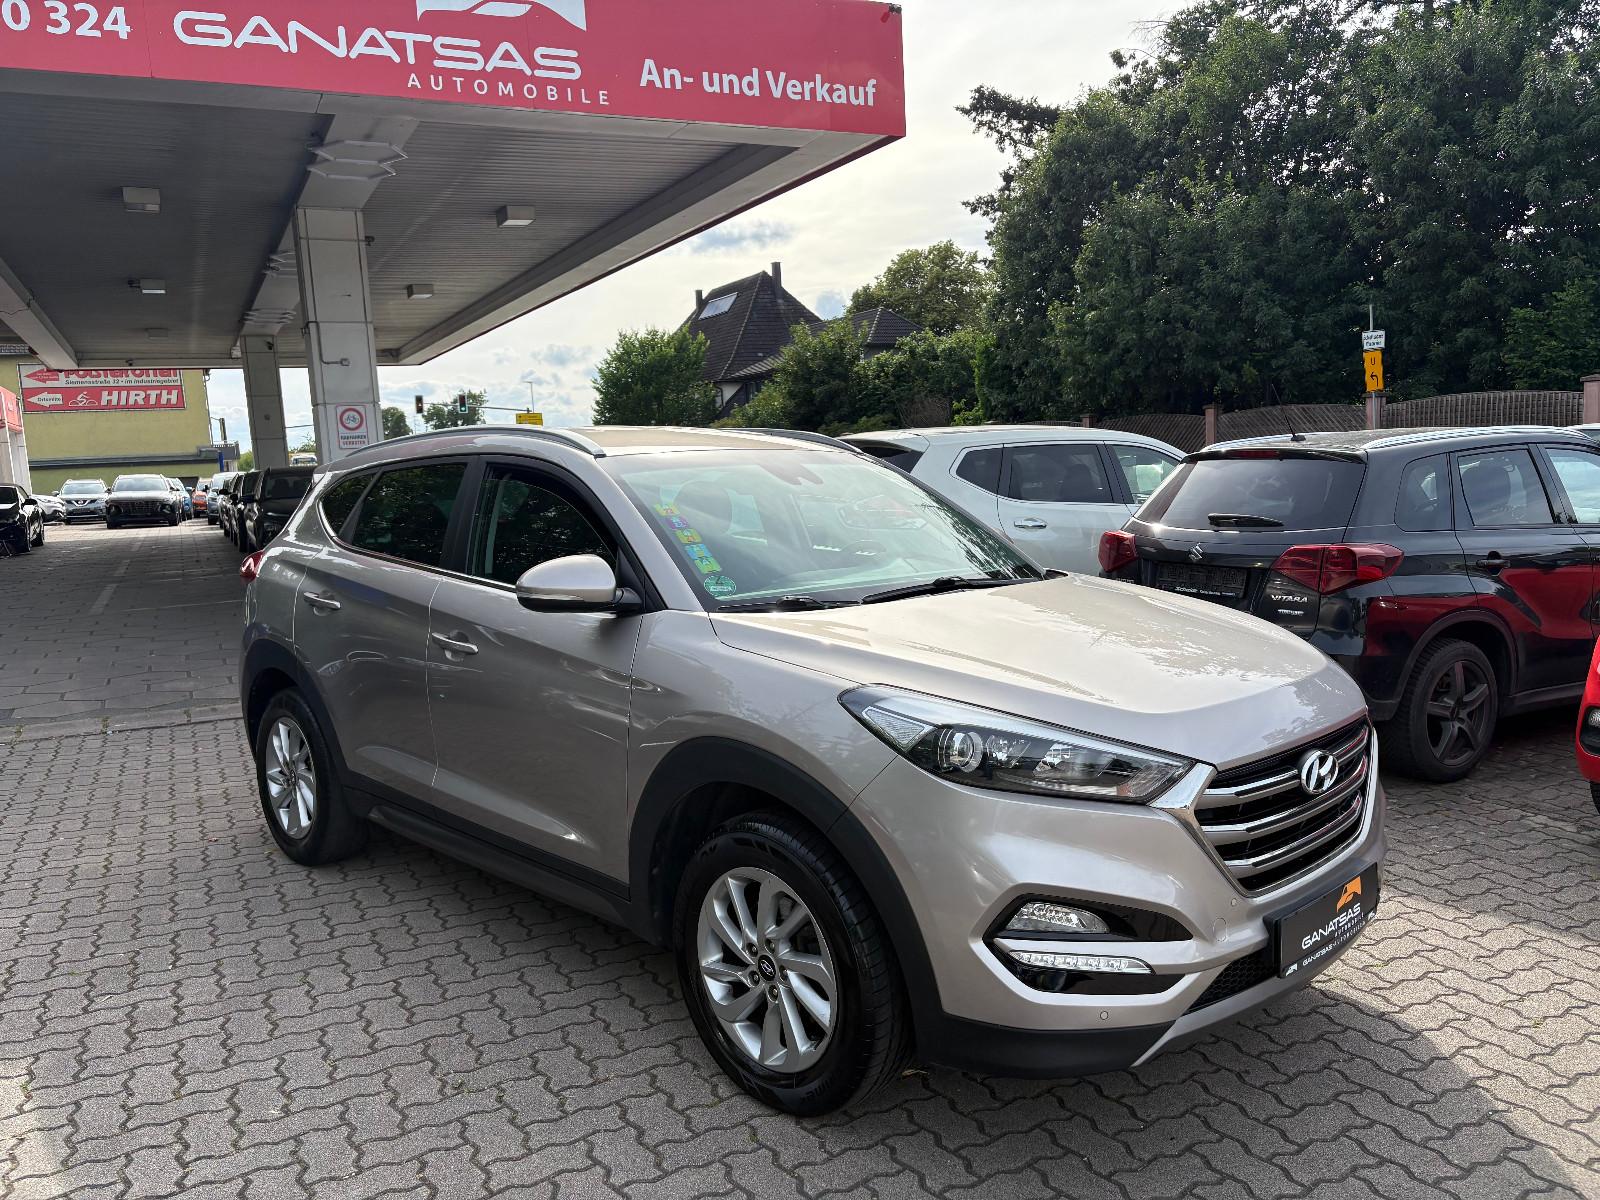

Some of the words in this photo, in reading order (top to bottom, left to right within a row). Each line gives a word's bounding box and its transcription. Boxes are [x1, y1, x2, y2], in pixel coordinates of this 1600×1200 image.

[44, 0, 131, 40] 324
[173, 11, 582, 81] GANATSAS
[407, 72, 611, 106] AUTOMOBILE
[639, 58, 694, 90] An-
[702, 67, 761, 97] und
[765, 70, 877, 106] Verkauf
[100, 389, 179, 406] HIRTH
[1270, 594, 1309, 604] VITARA
[1301, 902, 1361, 950] GANATSAS
